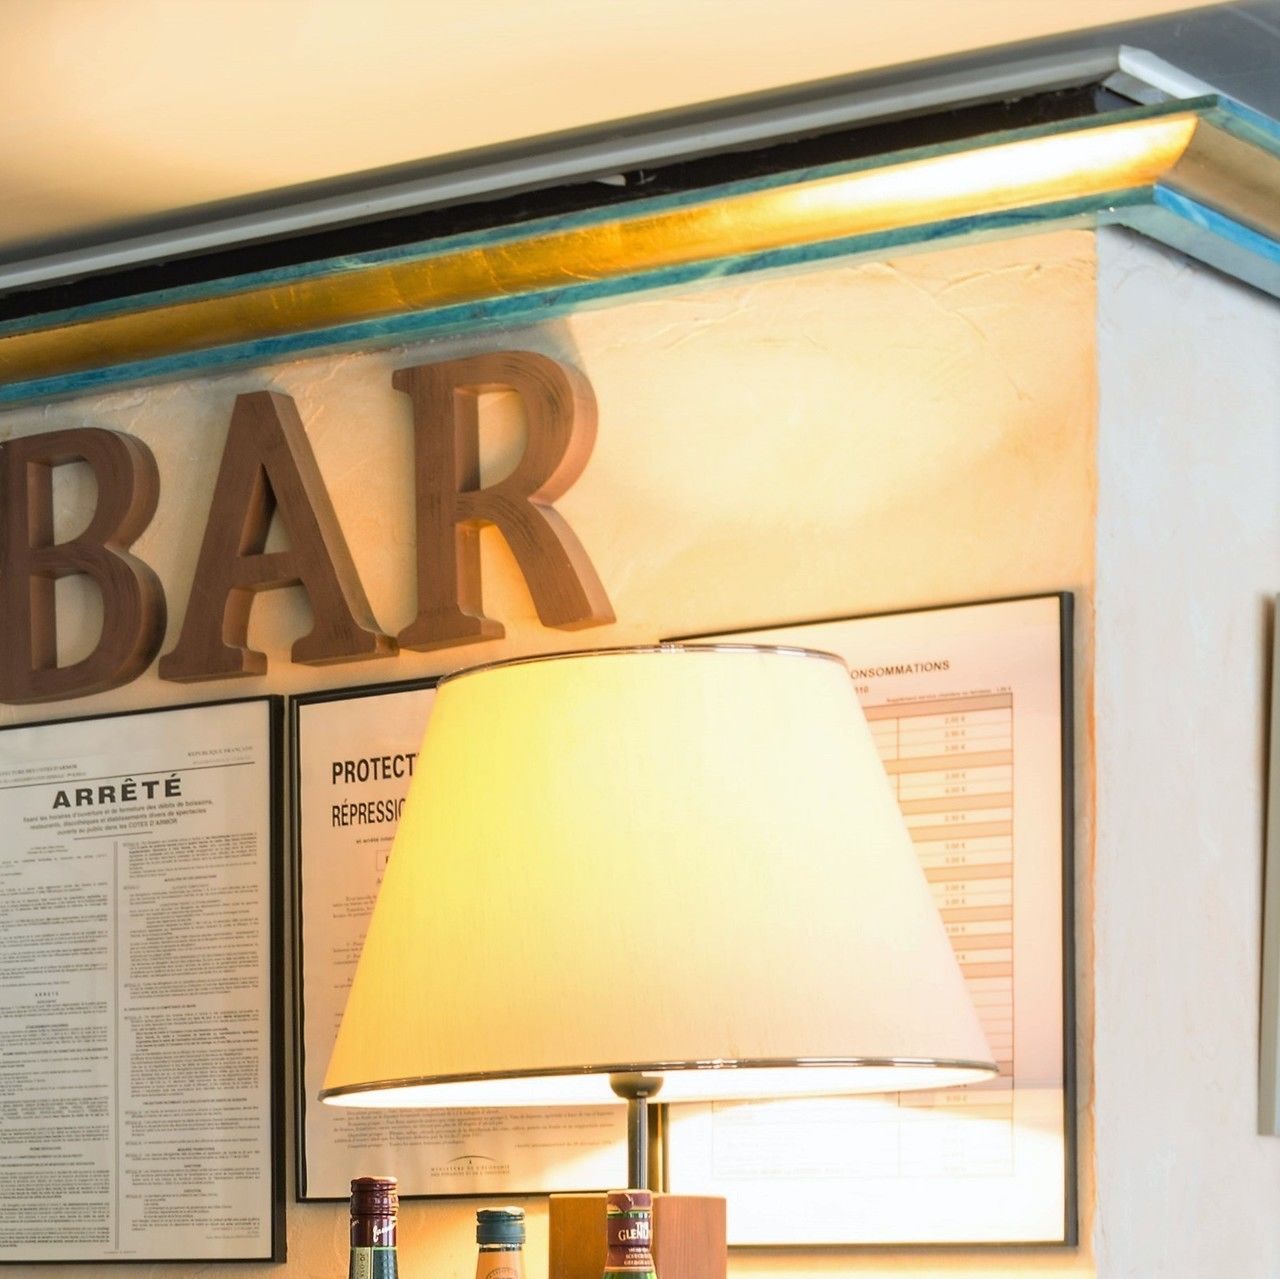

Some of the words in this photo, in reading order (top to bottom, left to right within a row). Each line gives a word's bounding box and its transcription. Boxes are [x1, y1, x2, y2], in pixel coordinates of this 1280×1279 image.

[850, 659, 950, 680] ONSOMMATIONS
[332, 753, 419, 785] PROTECT
[52, 773, 182, 810] ARRÊTÉ
